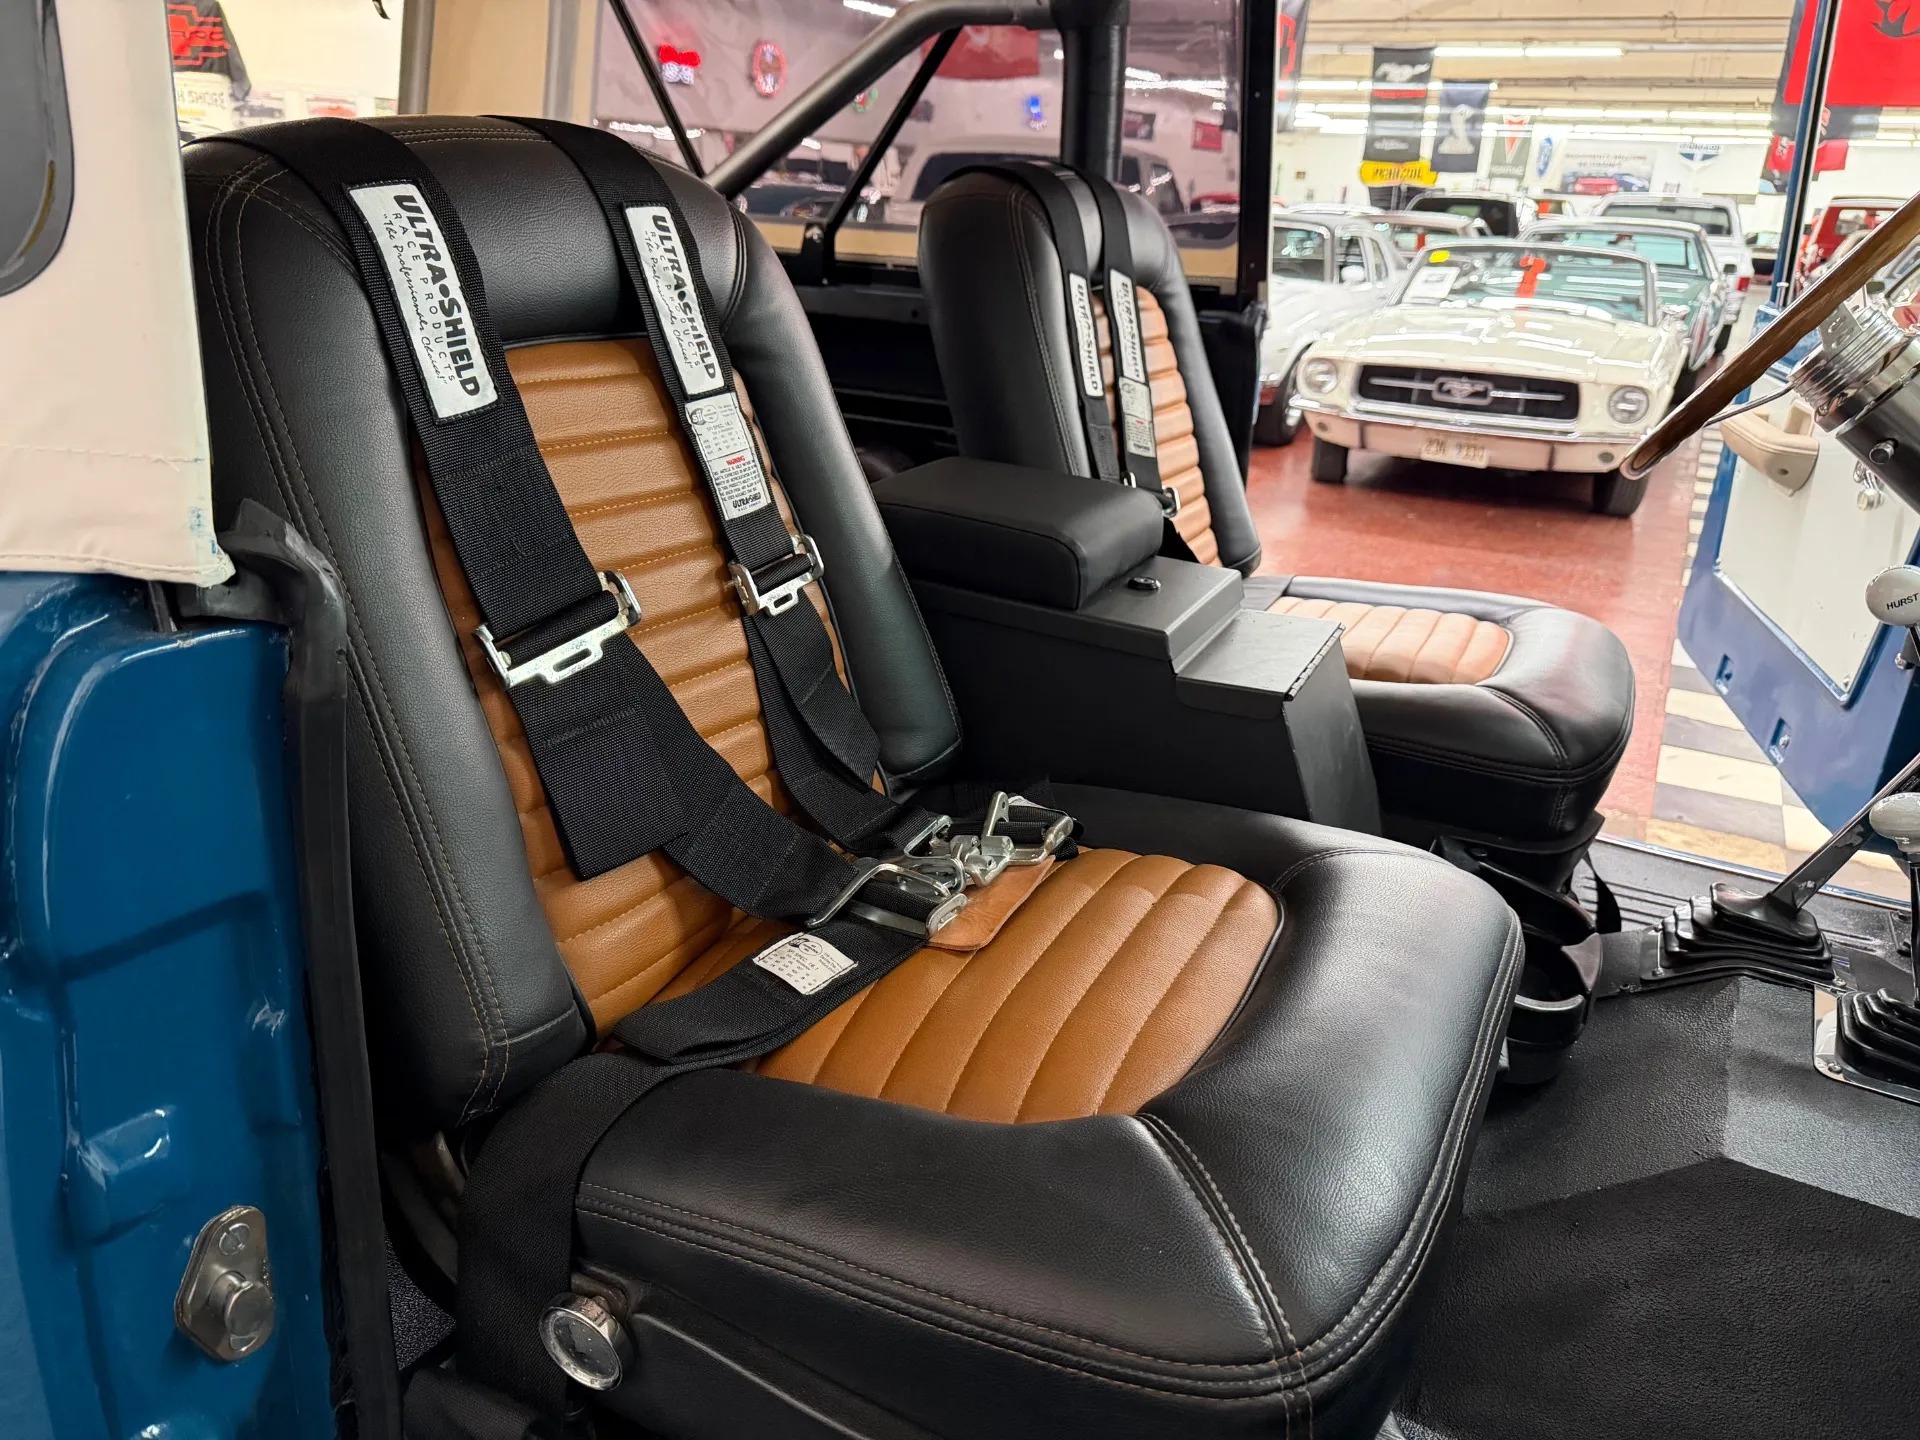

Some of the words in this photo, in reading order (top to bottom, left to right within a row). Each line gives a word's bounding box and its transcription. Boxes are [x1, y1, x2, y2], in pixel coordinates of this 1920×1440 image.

[392, 212, 421, 261] RACE
[420, 277, 456, 382] PRODUCTS
[649, 231, 670, 272] RACE
[664, 284, 701, 367] PRODUCTS
[1886, 592, 1919, 610] HURST
